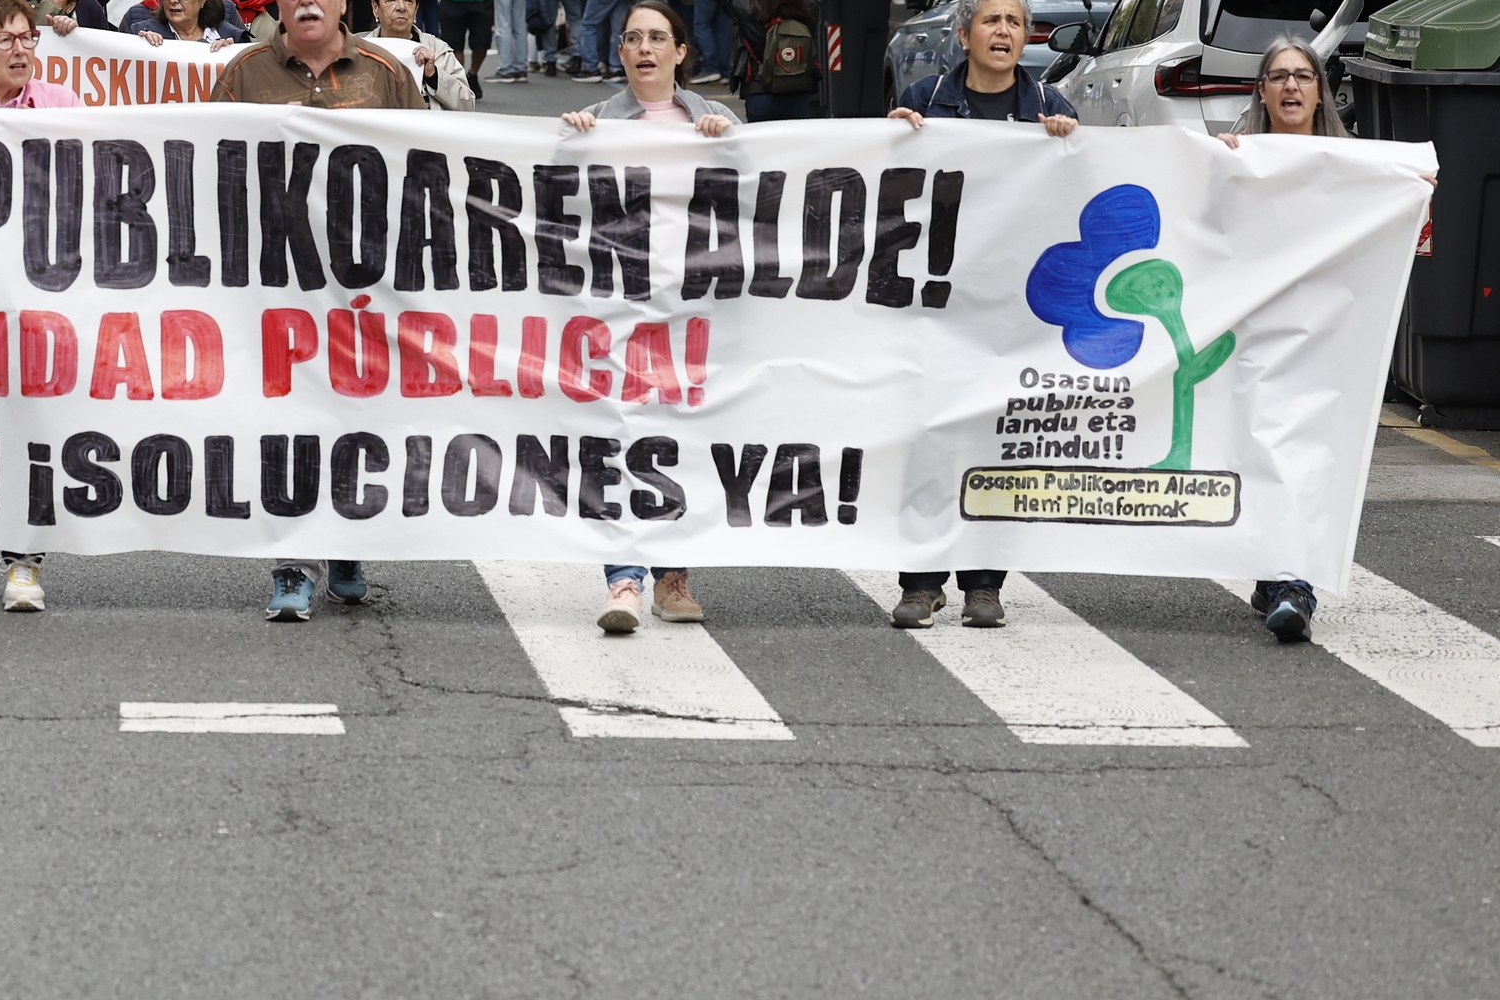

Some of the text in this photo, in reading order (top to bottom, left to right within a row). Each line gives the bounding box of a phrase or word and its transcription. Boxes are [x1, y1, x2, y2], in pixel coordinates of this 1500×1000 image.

[680, 166, 965, 310] ALDE!
[261, 294, 710, 407] PÚBLICA!
[1019, 367, 1131, 393] Osasun
[1005, 393, 1135, 416] publikoa
[995, 411, 1136, 435] landu eta
[1000, 434, 1124, 461] zaindu!!
[27, 430, 687, 528] ¡SOLUCIONES
[710, 443, 864, 527] YA!
[968, 474, 1039, 491] Osasun
[1013, 494, 1062, 513] Herri
